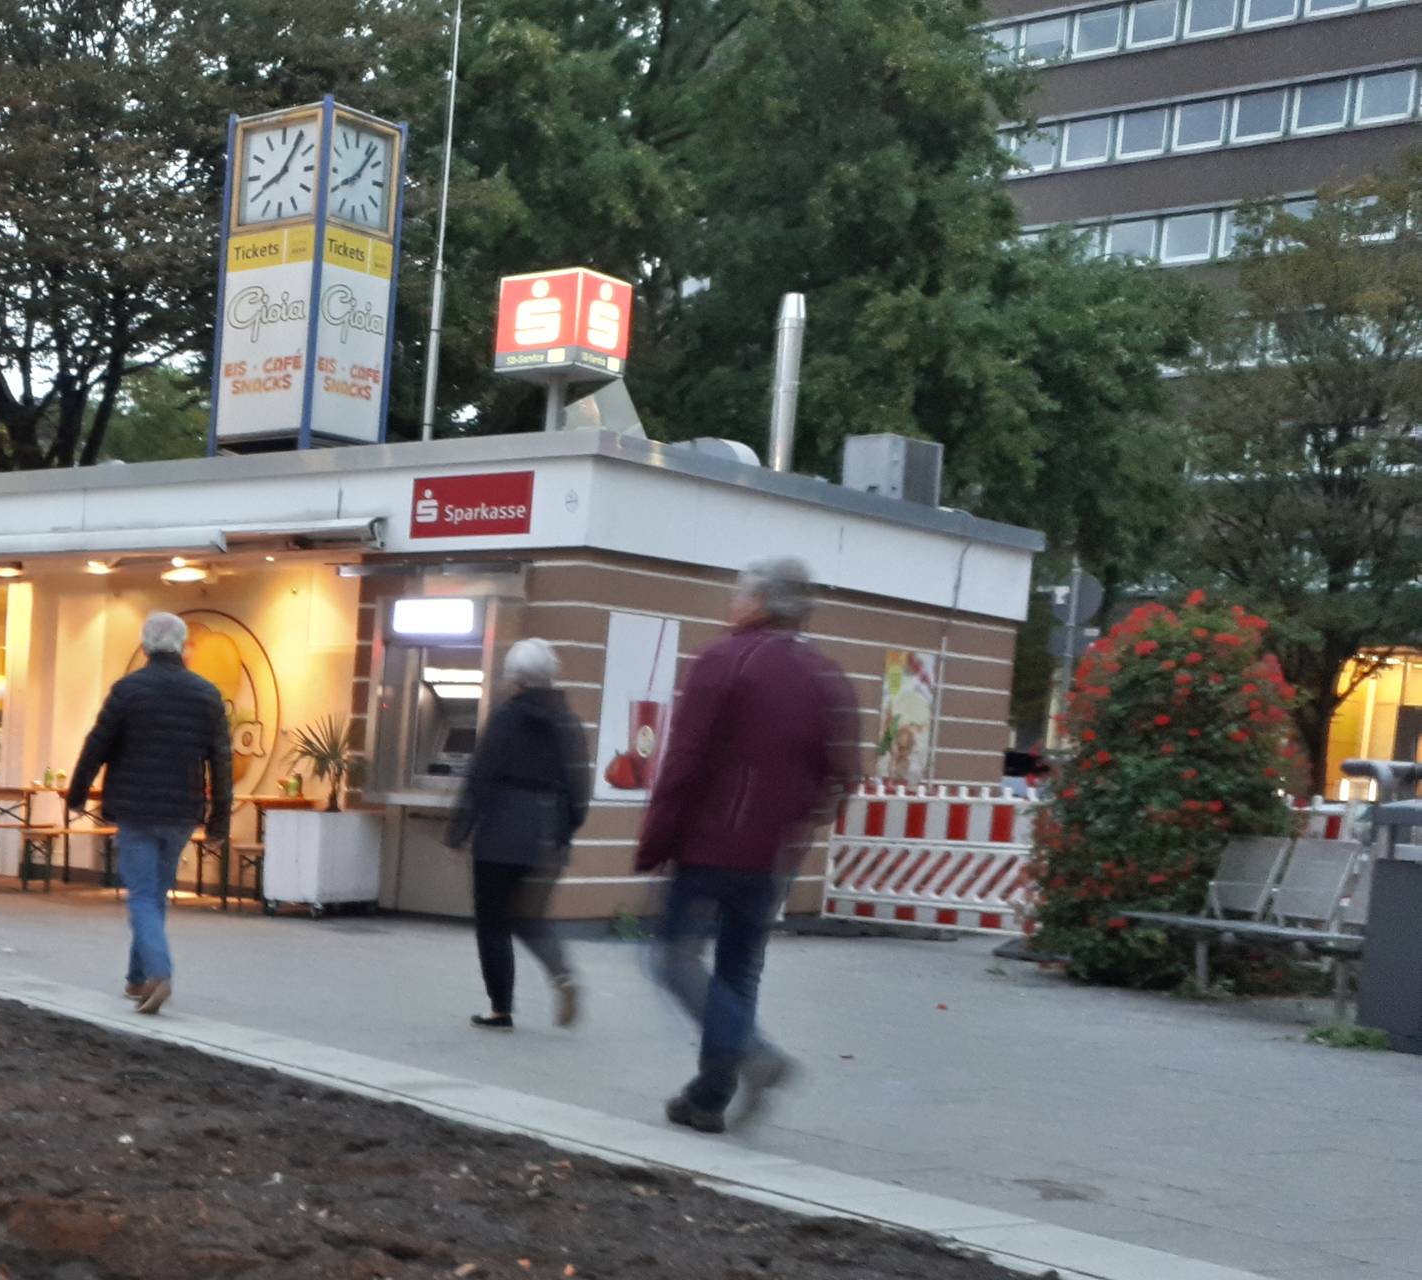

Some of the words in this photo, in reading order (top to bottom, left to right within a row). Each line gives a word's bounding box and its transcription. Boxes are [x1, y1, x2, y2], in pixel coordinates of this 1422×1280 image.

[234, 242, 280, 261] Tickets
[328, 238, 365, 262] Tickets
[227, 285, 307, 343] Gioia
[322, 283, 384, 344] Gioia
[224, 361, 247, 377] EIS
[318, 357, 336, 373] EIS
[231, 374, 292, 395] SNACKS
[323, 376, 372, 400] SNACKS
[444, 502, 527, 525] Sparkasse
